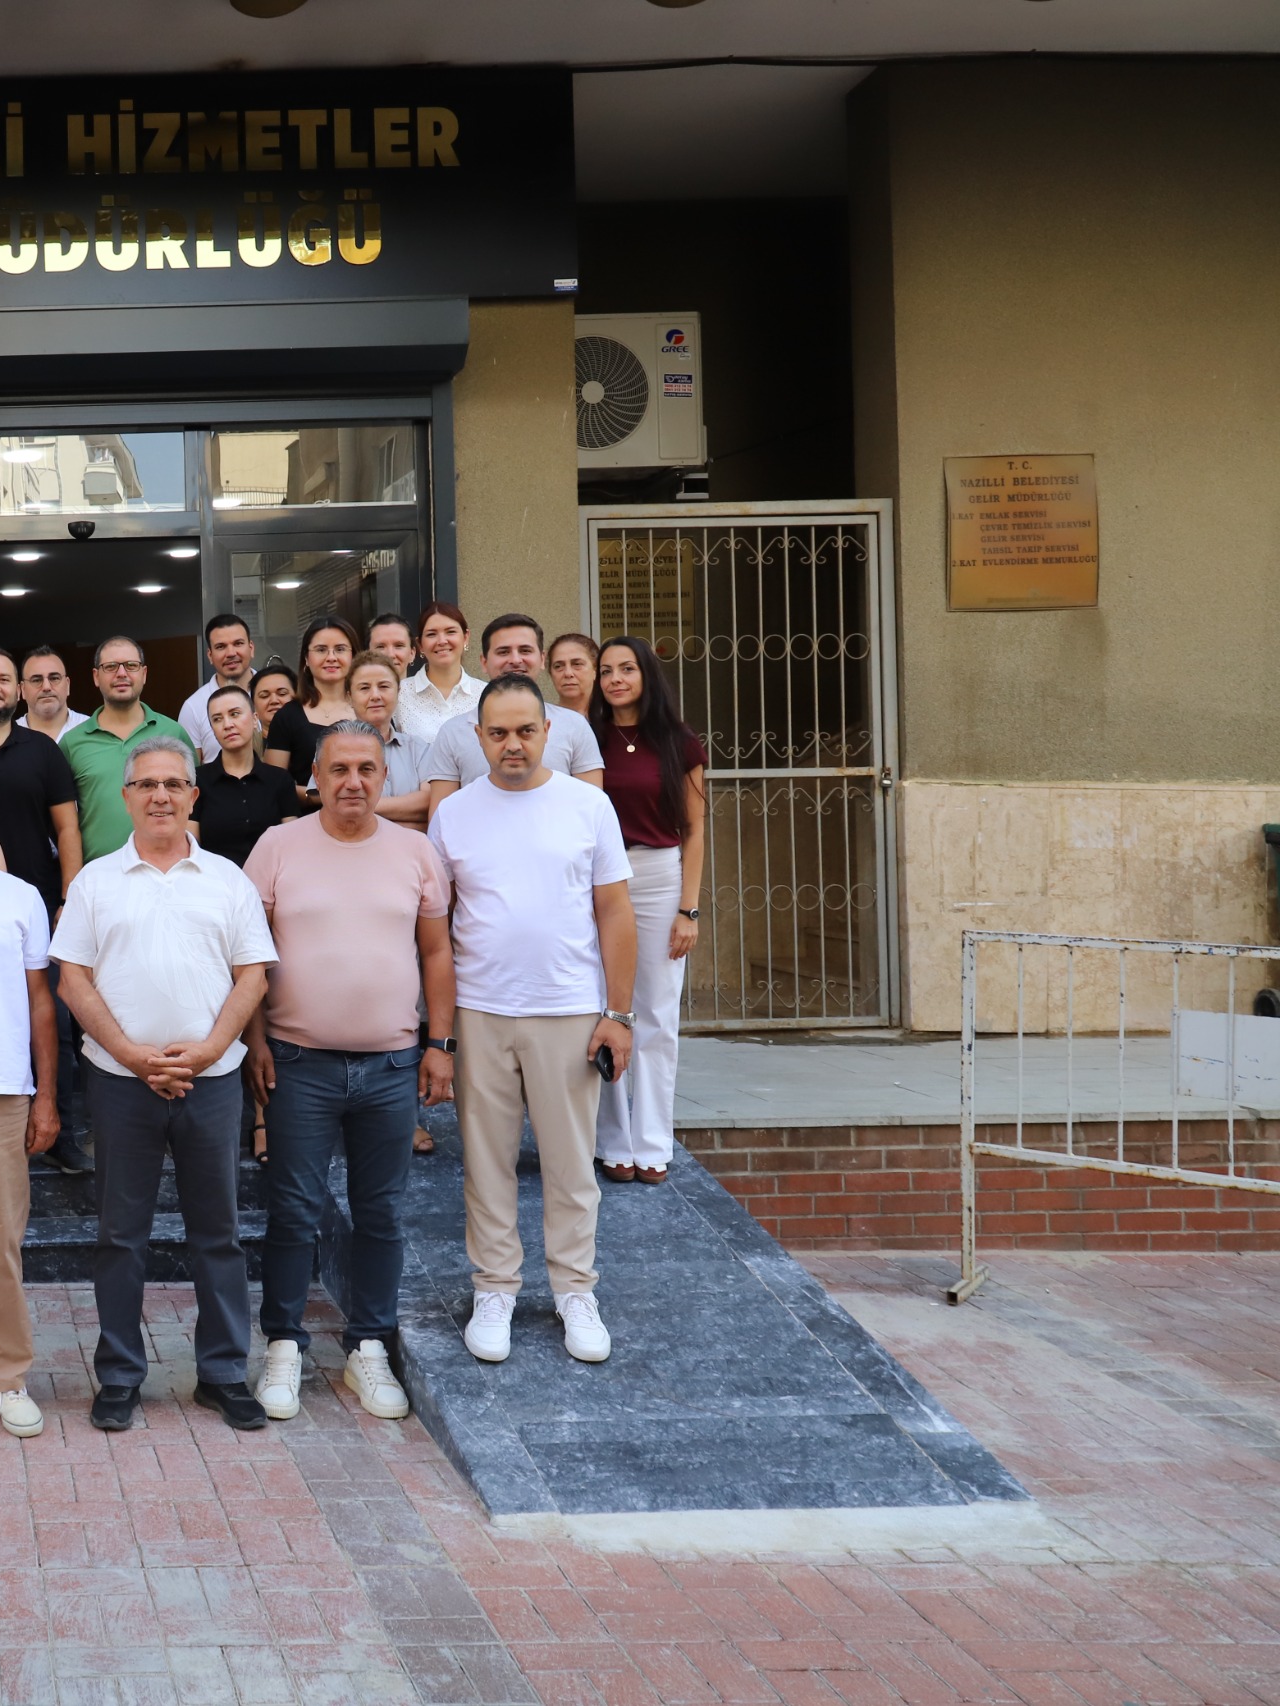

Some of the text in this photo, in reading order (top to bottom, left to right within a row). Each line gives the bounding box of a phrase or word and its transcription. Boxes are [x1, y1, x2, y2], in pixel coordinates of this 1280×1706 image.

[67, 98, 461, 175] HİZMETLER
[960, 475, 1080, 488] NAZİLLİ BELEDİYESİ
[969, 491, 1072, 504] GELİR MÜDÜRLÜĞÜ
[980, 523, 1008, 532] ÇEVRE
[983, 557, 1040, 566] EVLENDİRME
